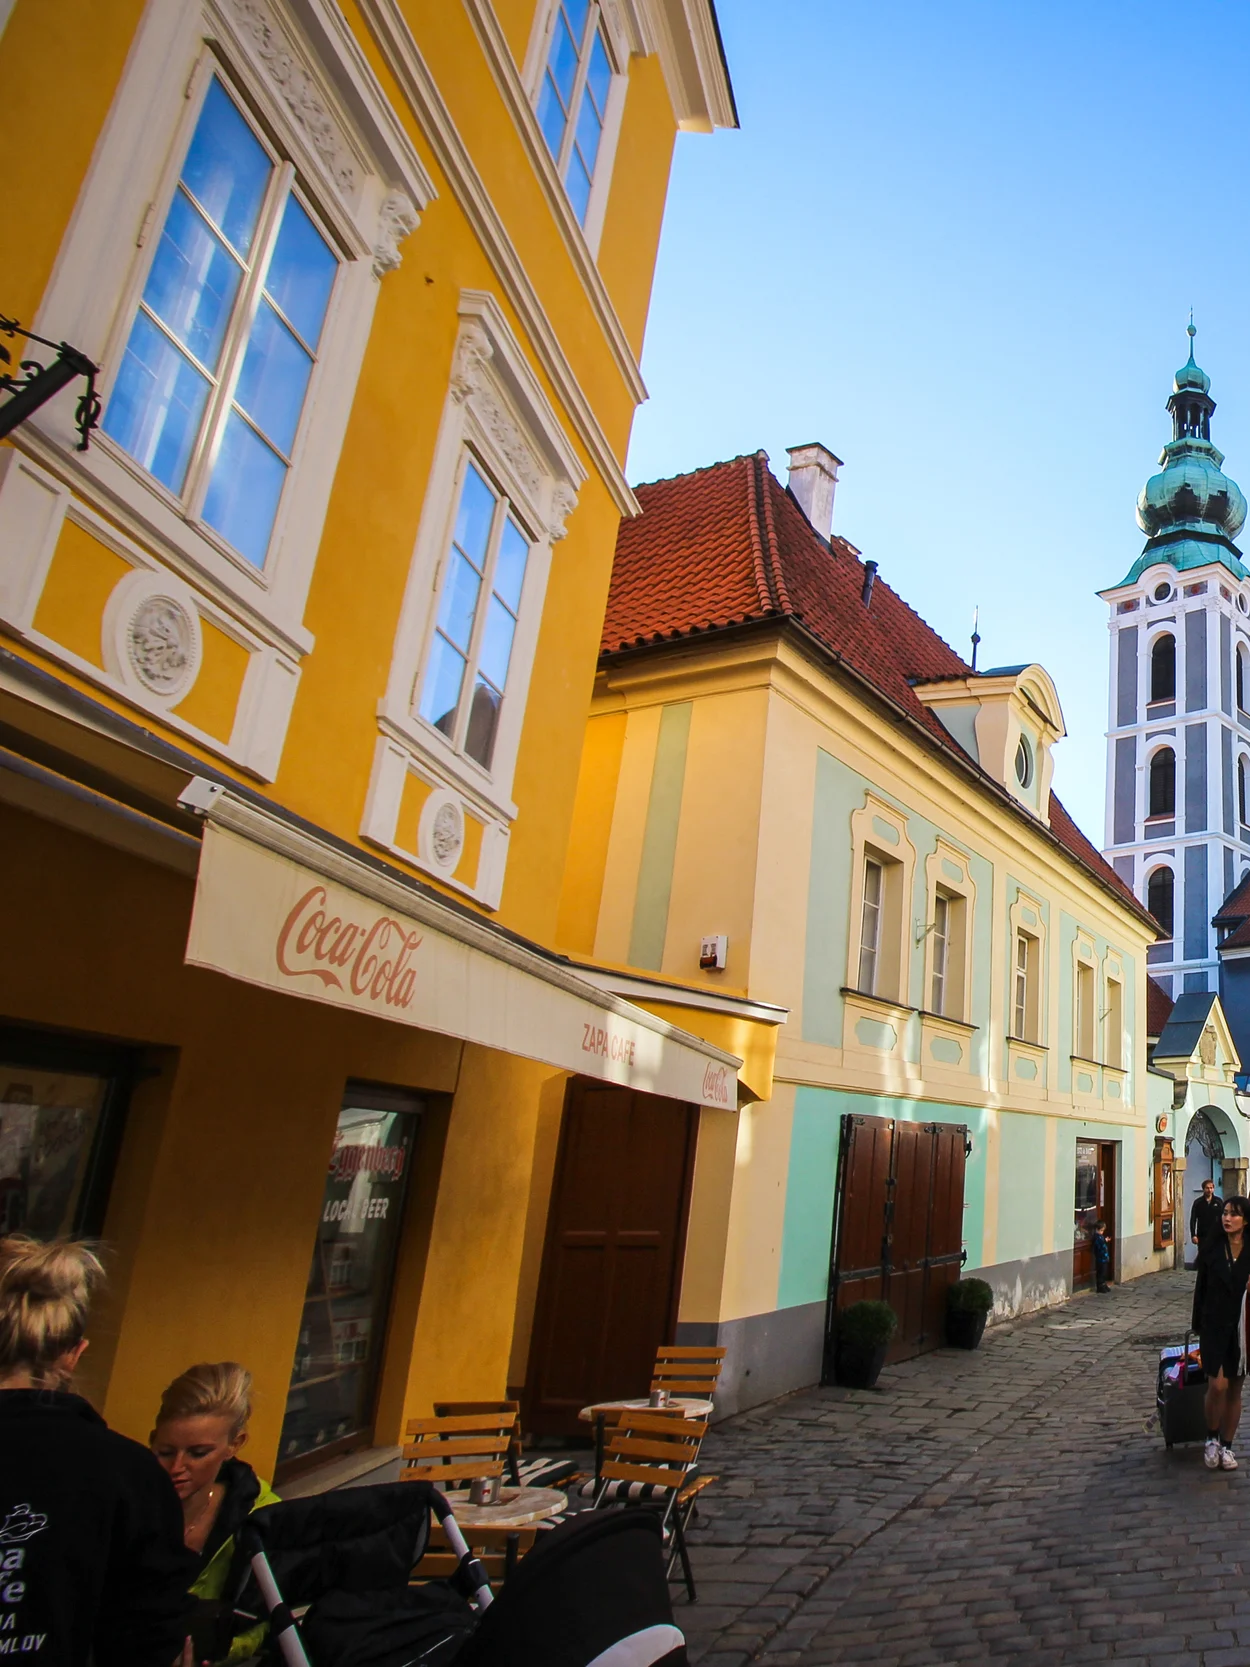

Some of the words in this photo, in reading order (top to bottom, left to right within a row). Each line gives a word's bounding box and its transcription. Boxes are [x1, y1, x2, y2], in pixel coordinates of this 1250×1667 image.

[276, 885, 424, 1009] Coca-Cola
[581, 1022, 609, 1058] ZAPA
[610, 1034, 636, 1067] CAFE
[360, 1197, 390, 1220] BEER
